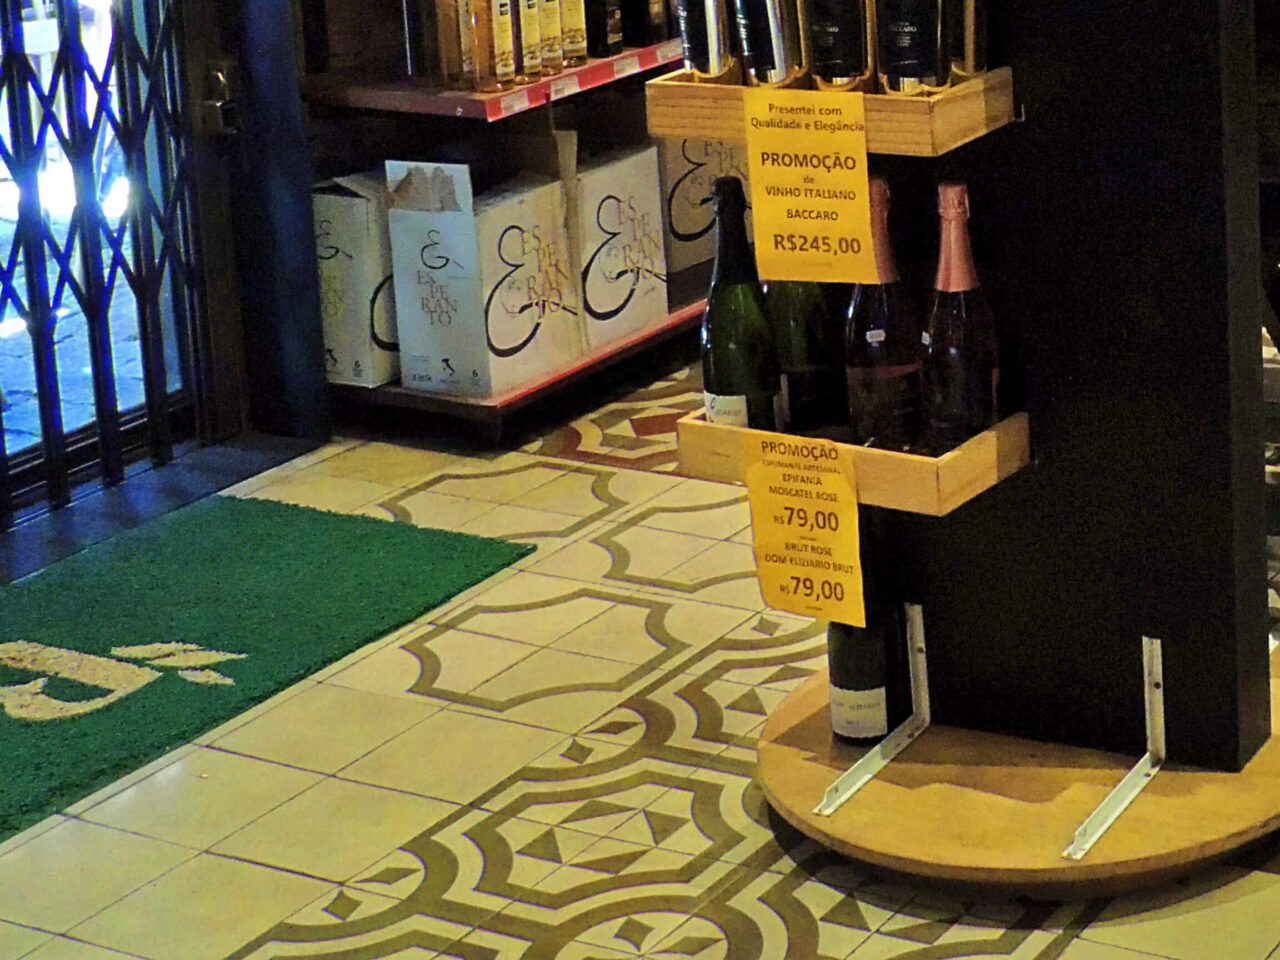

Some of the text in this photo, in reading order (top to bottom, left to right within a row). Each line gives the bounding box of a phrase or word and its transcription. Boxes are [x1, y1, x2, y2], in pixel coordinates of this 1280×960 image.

[819, 107, 842, 116] com
[751, 117, 802, 130] Qualidade
[814, 120, 865, 133] Elegância
[761, 152, 856, 173] PROMOÇÃO
[765, 186, 856, 200] VINHO ITALIANO
[787, 209, 838, 221] BACCARO
[773, 234, 862, 256] R$245,00
[761, 440, 838, 461] PROMOÇÃO
[782, 473, 822, 486] EPIFANIA
[769, 485, 813, 499] MOSCATEL
[784, 542, 808, 552] BRUT
[765, 554, 787, 564] DOM
[832, 562, 854, 574] BRUT
